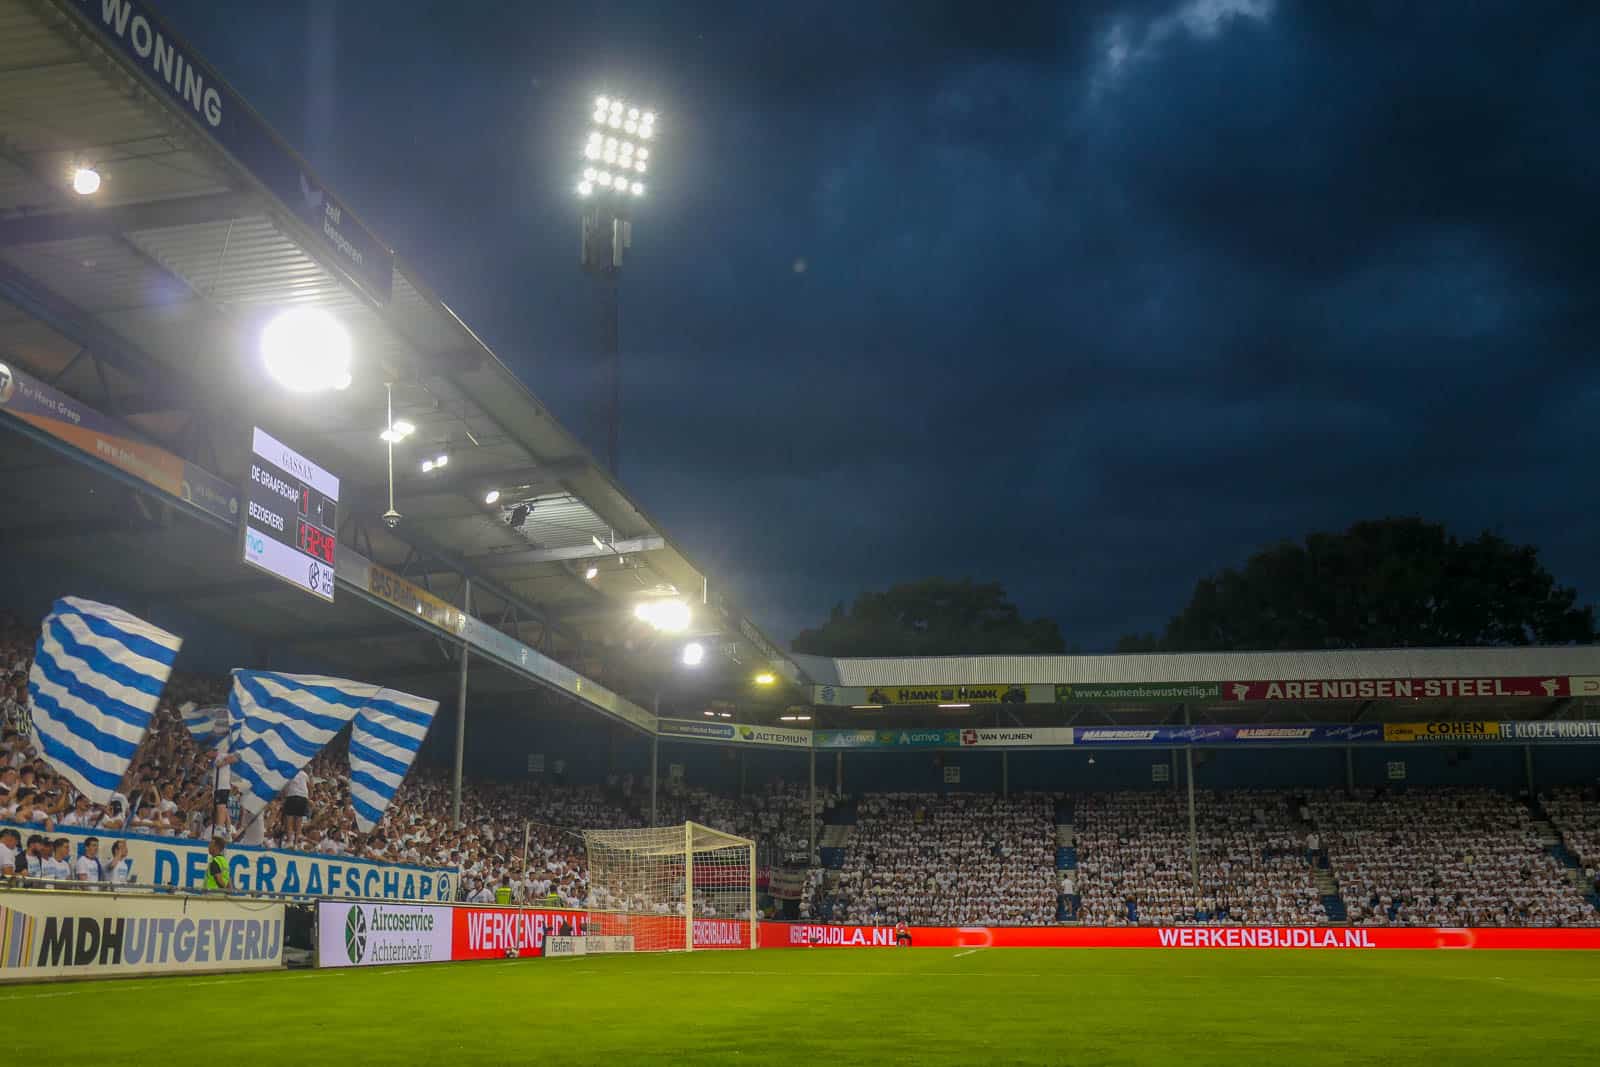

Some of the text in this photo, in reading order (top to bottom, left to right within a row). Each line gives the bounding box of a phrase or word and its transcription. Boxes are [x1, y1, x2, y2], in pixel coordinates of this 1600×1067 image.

[100, 0, 222, 126] WONING
[251, 465, 260, 482] DE
[261, 471, 299, 502] GRAAFSCHAP
[249, 501, 284, 531] BEZOEKERS
[1074, 685, 1219, 699] www.samenbewustveilig.nl
[1265, 679, 1511, 699] ARENDSEN-STEEL
[755, 732, 808, 744] ACTEMIUM
[1426, 722, 1485, 734] COHEN
[1500, 723, 1512, 738] TE
[1515, 722, 1556, 738] KLOEZE
[153, 848, 209, 893] DE
[229, 854, 433, 900] GRAAFSCHAP
[370, 906, 434, 932] Aircoservice
[1158, 929, 1376, 948] WERKENBIJDLA.NL
[370, 939, 422, 962] Achterhoek
